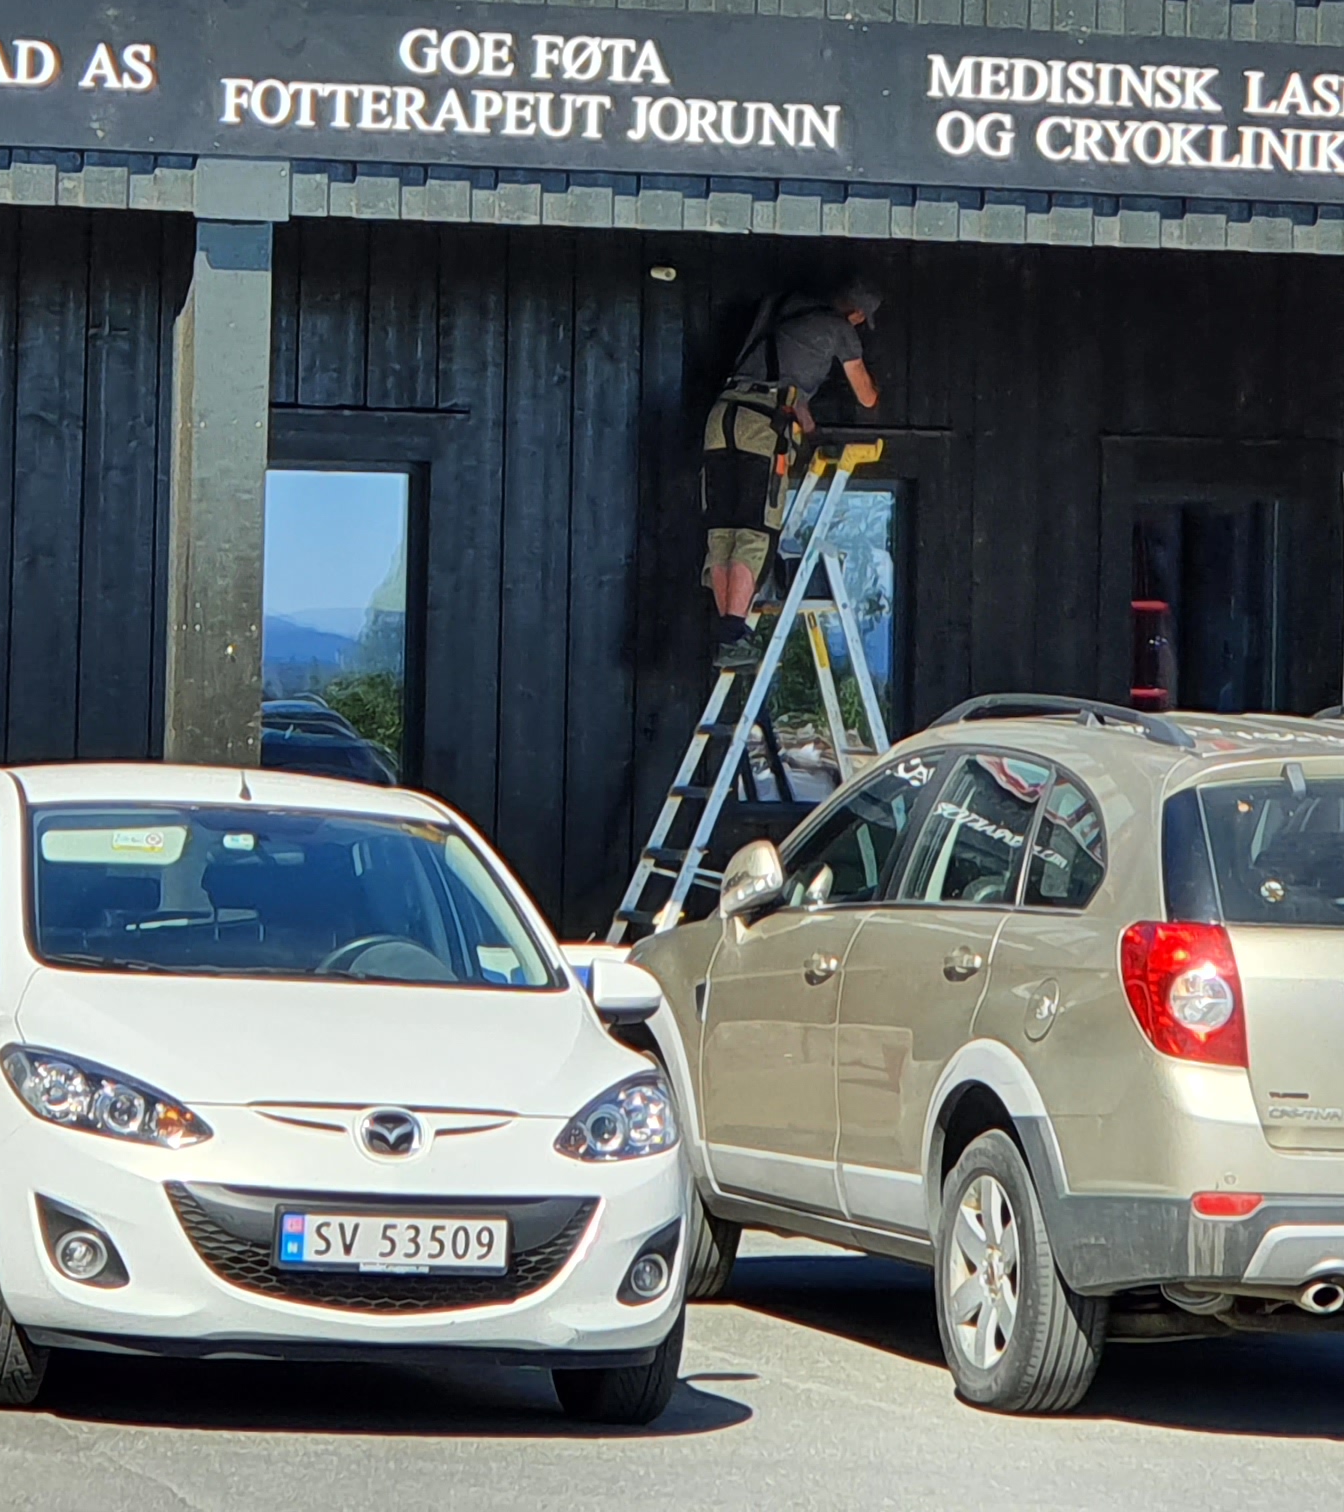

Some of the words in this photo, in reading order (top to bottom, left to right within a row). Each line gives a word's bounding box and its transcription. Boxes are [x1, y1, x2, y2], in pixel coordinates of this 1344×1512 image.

[79, 42, 155, 89] AS
[399, 28, 515, 78] GOE
[532, 34, 670, 85] FØTA
[927, 54, 1222, 113] MEDISINSK
[219, 78, 611, 139] FOTTERAPEUT
[628, 96, 843, 148] JORUNN
[936, 110, 1015, 159] OG
[313, 1221, 361, 1257] SV
[378, 1223, 495, 1261] 53509
